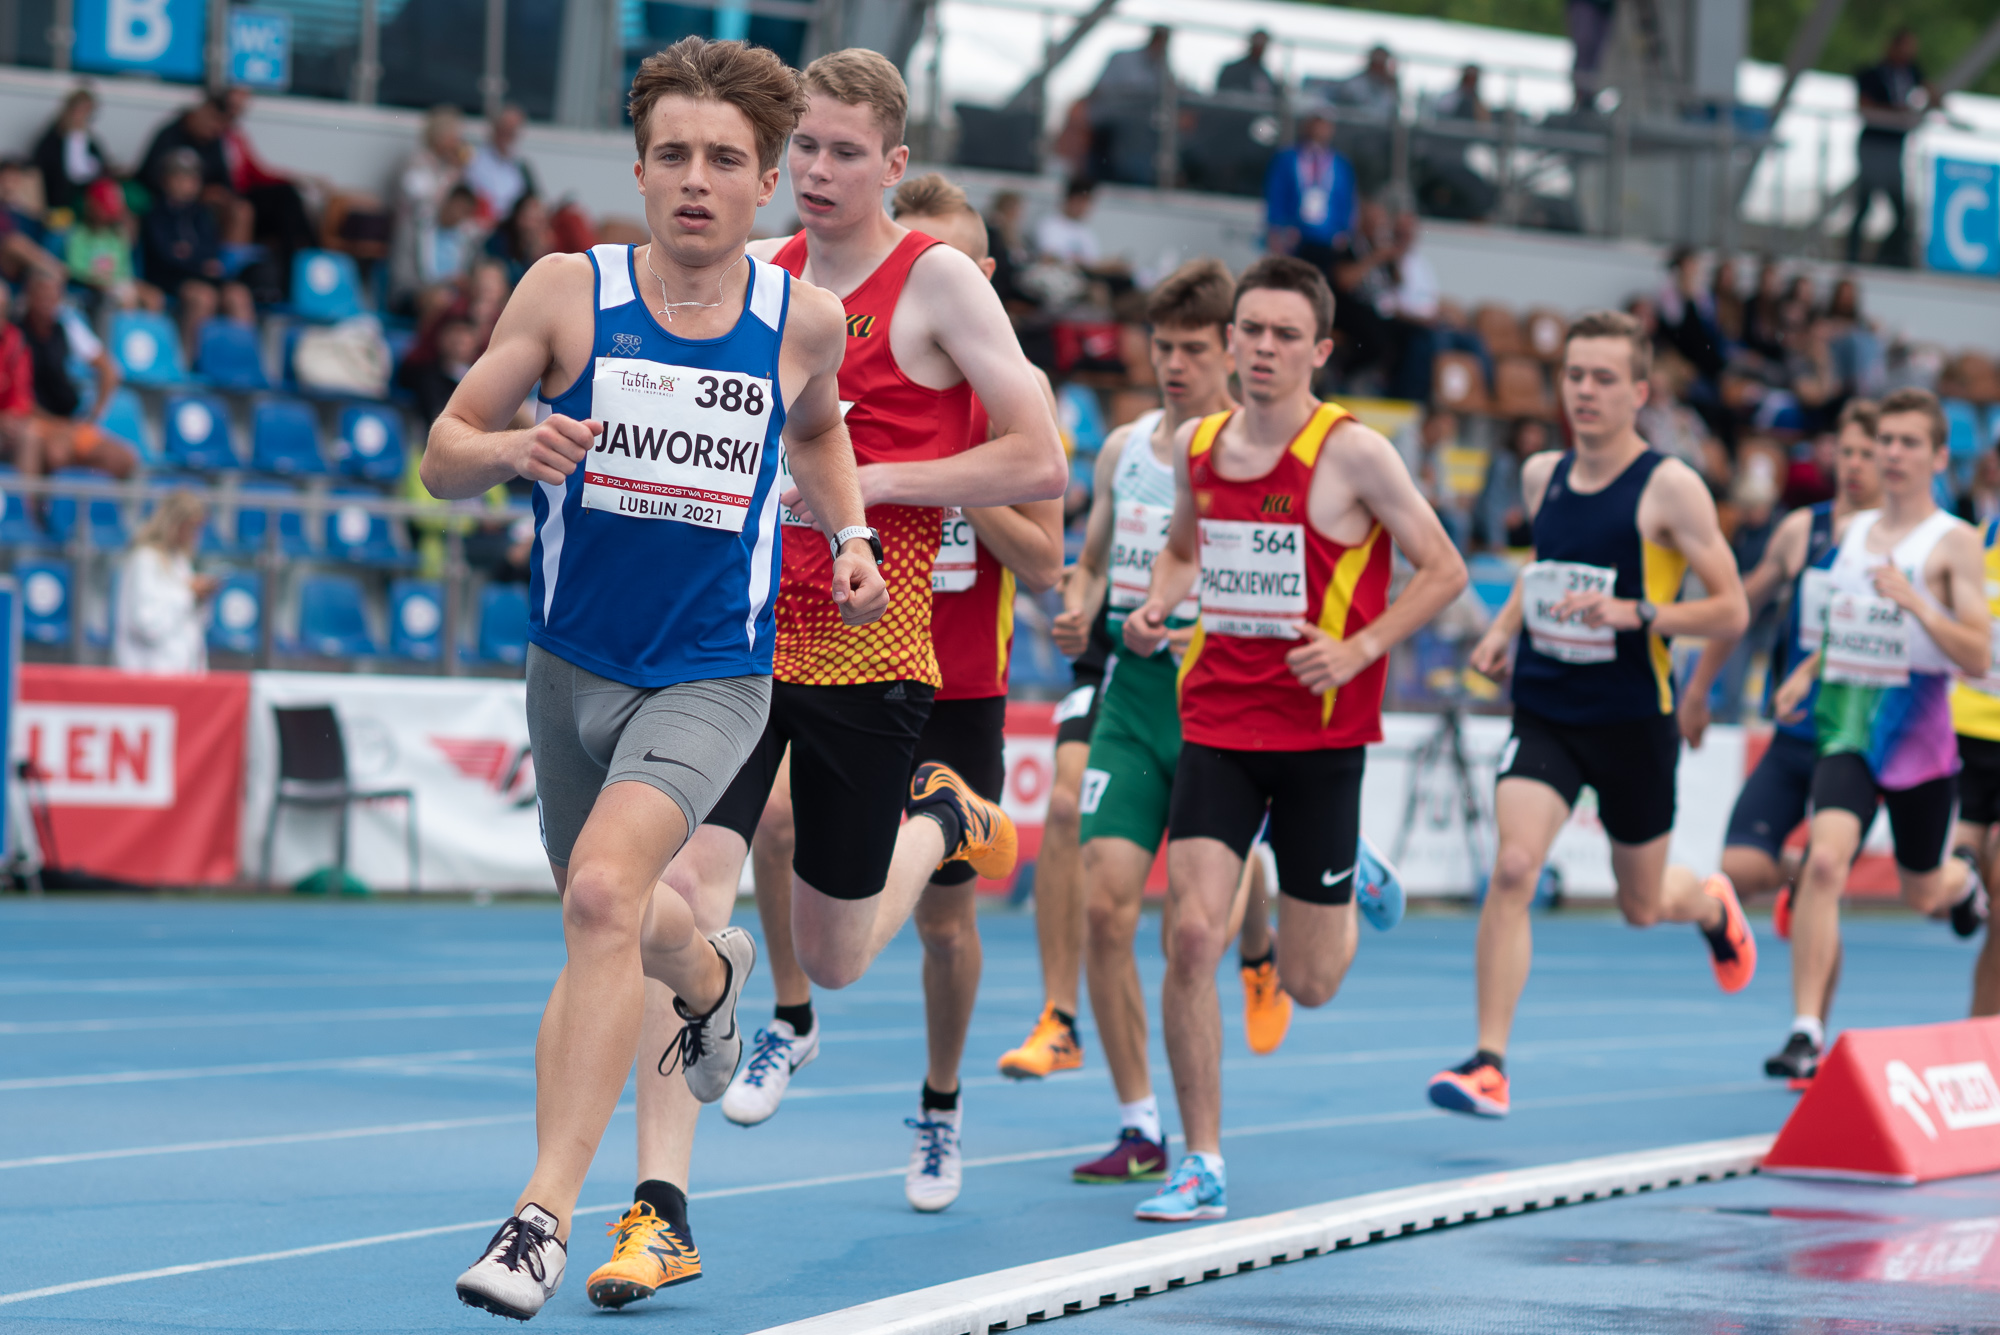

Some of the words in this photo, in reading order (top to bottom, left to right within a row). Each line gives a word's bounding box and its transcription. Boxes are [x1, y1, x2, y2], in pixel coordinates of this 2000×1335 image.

[104, 0, 172, 62] B
[1944, 185, 1991, 269] C
[694, 375, 764, 416] 388
[595, 420, 760, 475] JAWORSKI
[592, 475, 605, 484] 75.
[607, 477, 631, 489] PZLA
[631, 482, 701, 498] MISTRZOSTWA
[703, 492, 733, 503] POLSKI
[735, 496, 750, 505] U20
[619, 495, 678, 517] LUBLIN
[682, 504, 722, 525] 2021
[1252, 529, 1297, 555] 564
[1201, 567, 1301, 597] PĄCZKIEWICZ
[1218, 620, 1251, 632] LUBLIN
[1255, 623, 1281, 635] 2021
[531, 1215, 548, 1227] NIKE
